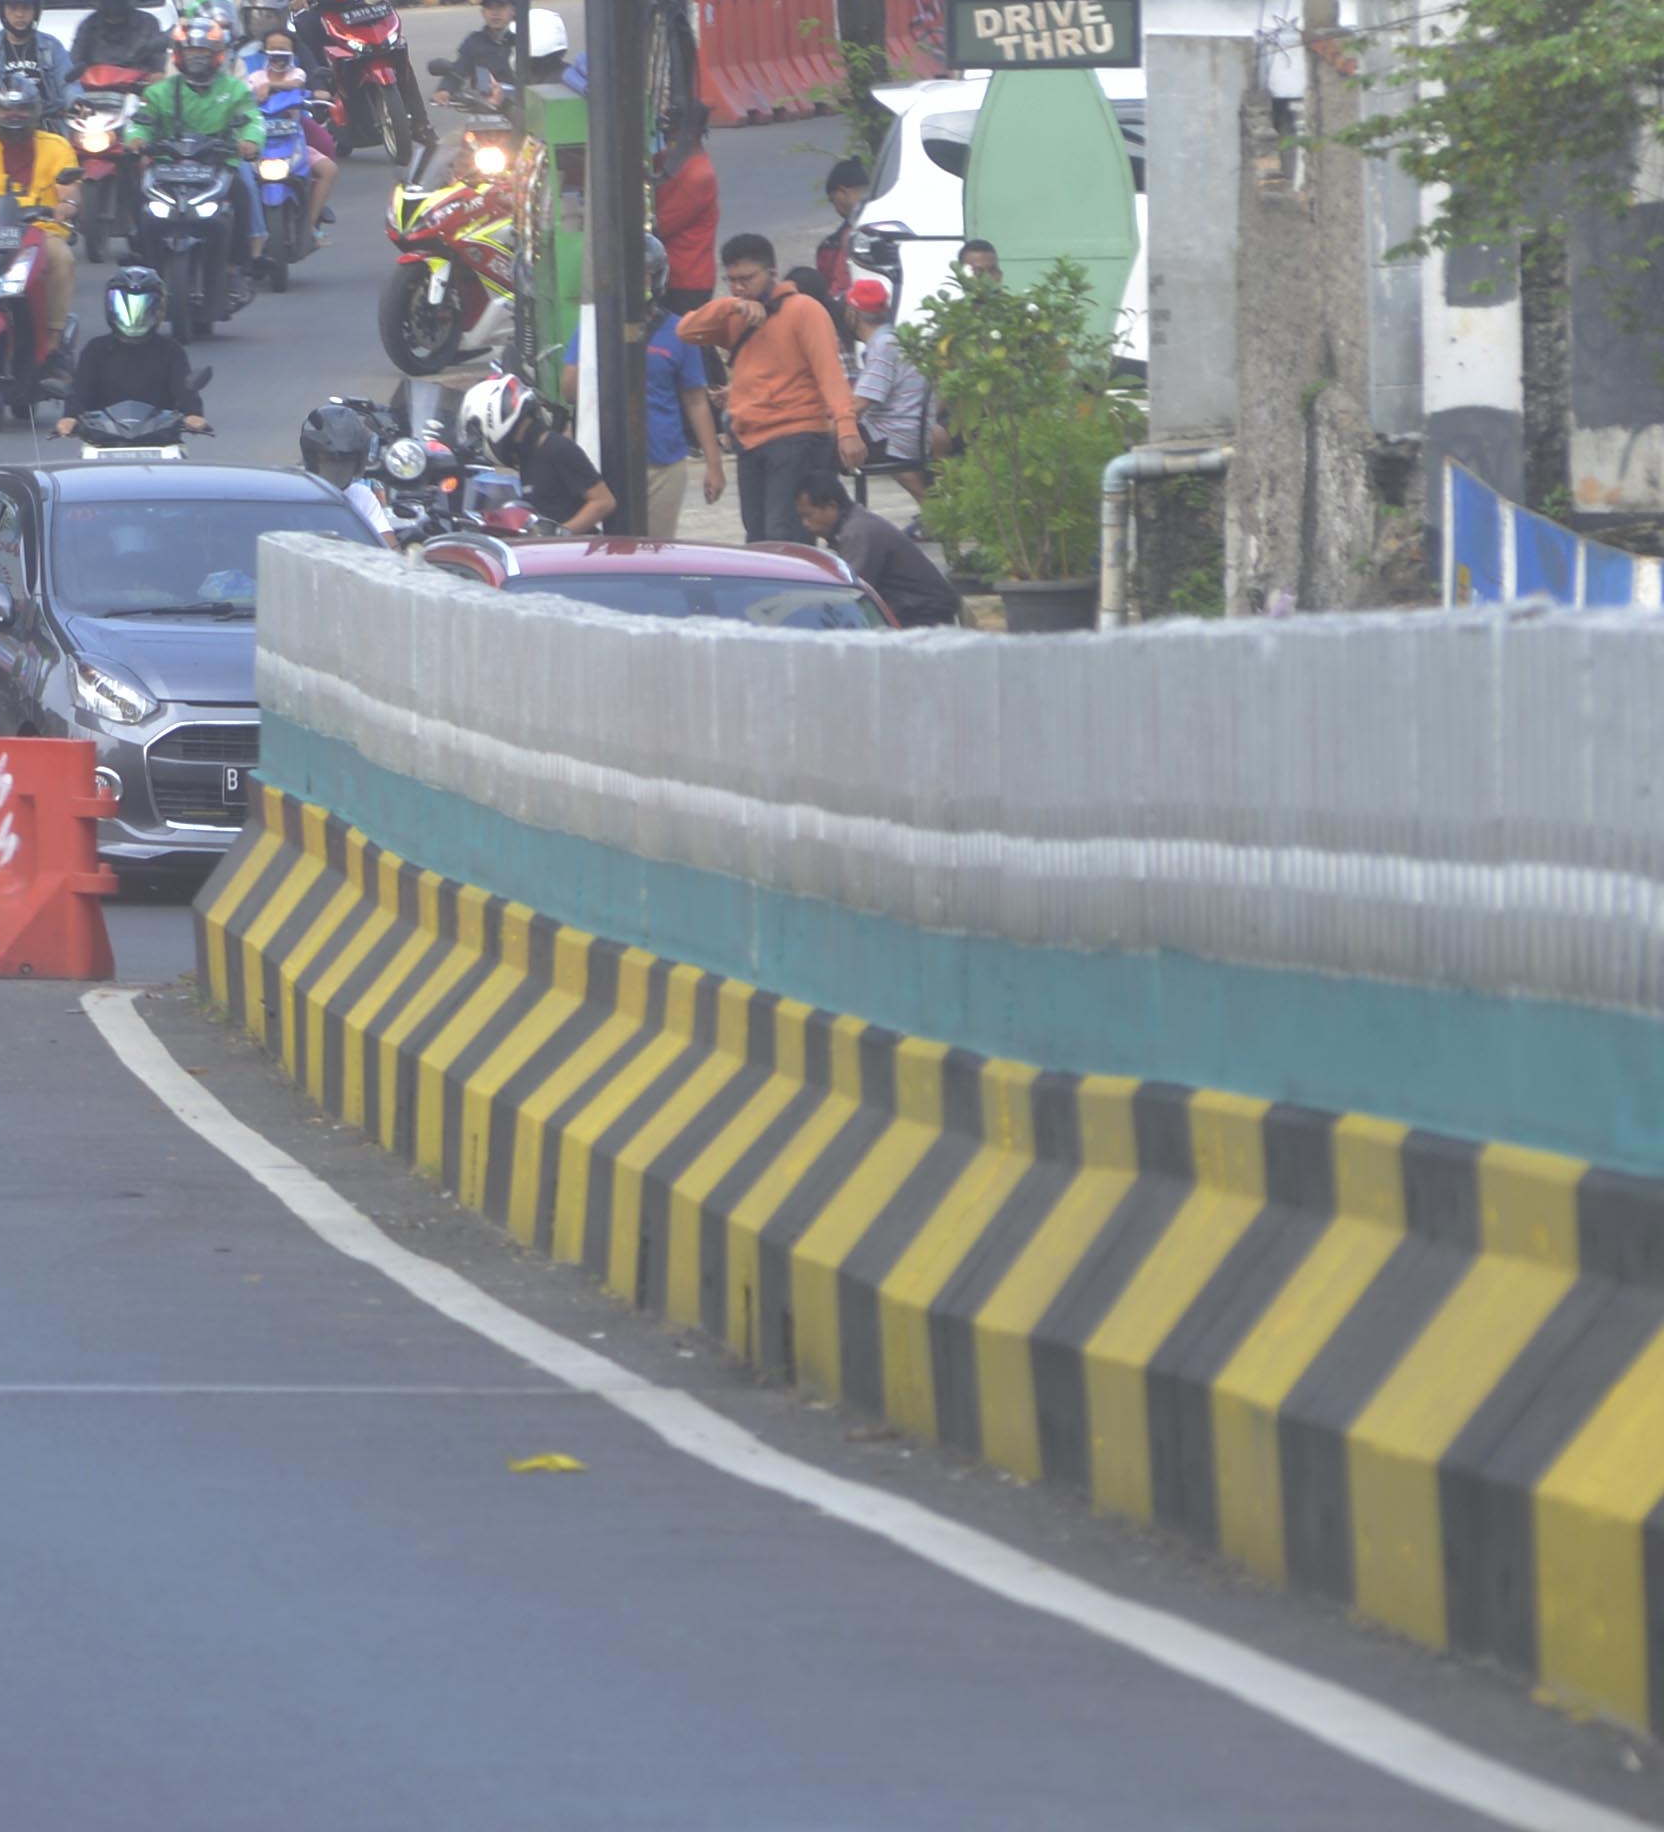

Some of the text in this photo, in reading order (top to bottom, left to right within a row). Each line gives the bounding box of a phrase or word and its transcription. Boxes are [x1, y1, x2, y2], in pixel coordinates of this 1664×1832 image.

[973, 0, 1106, 38] DRIVE
[994, 23, 1114, 61] THRU
[227, 767, 239, 791] B
